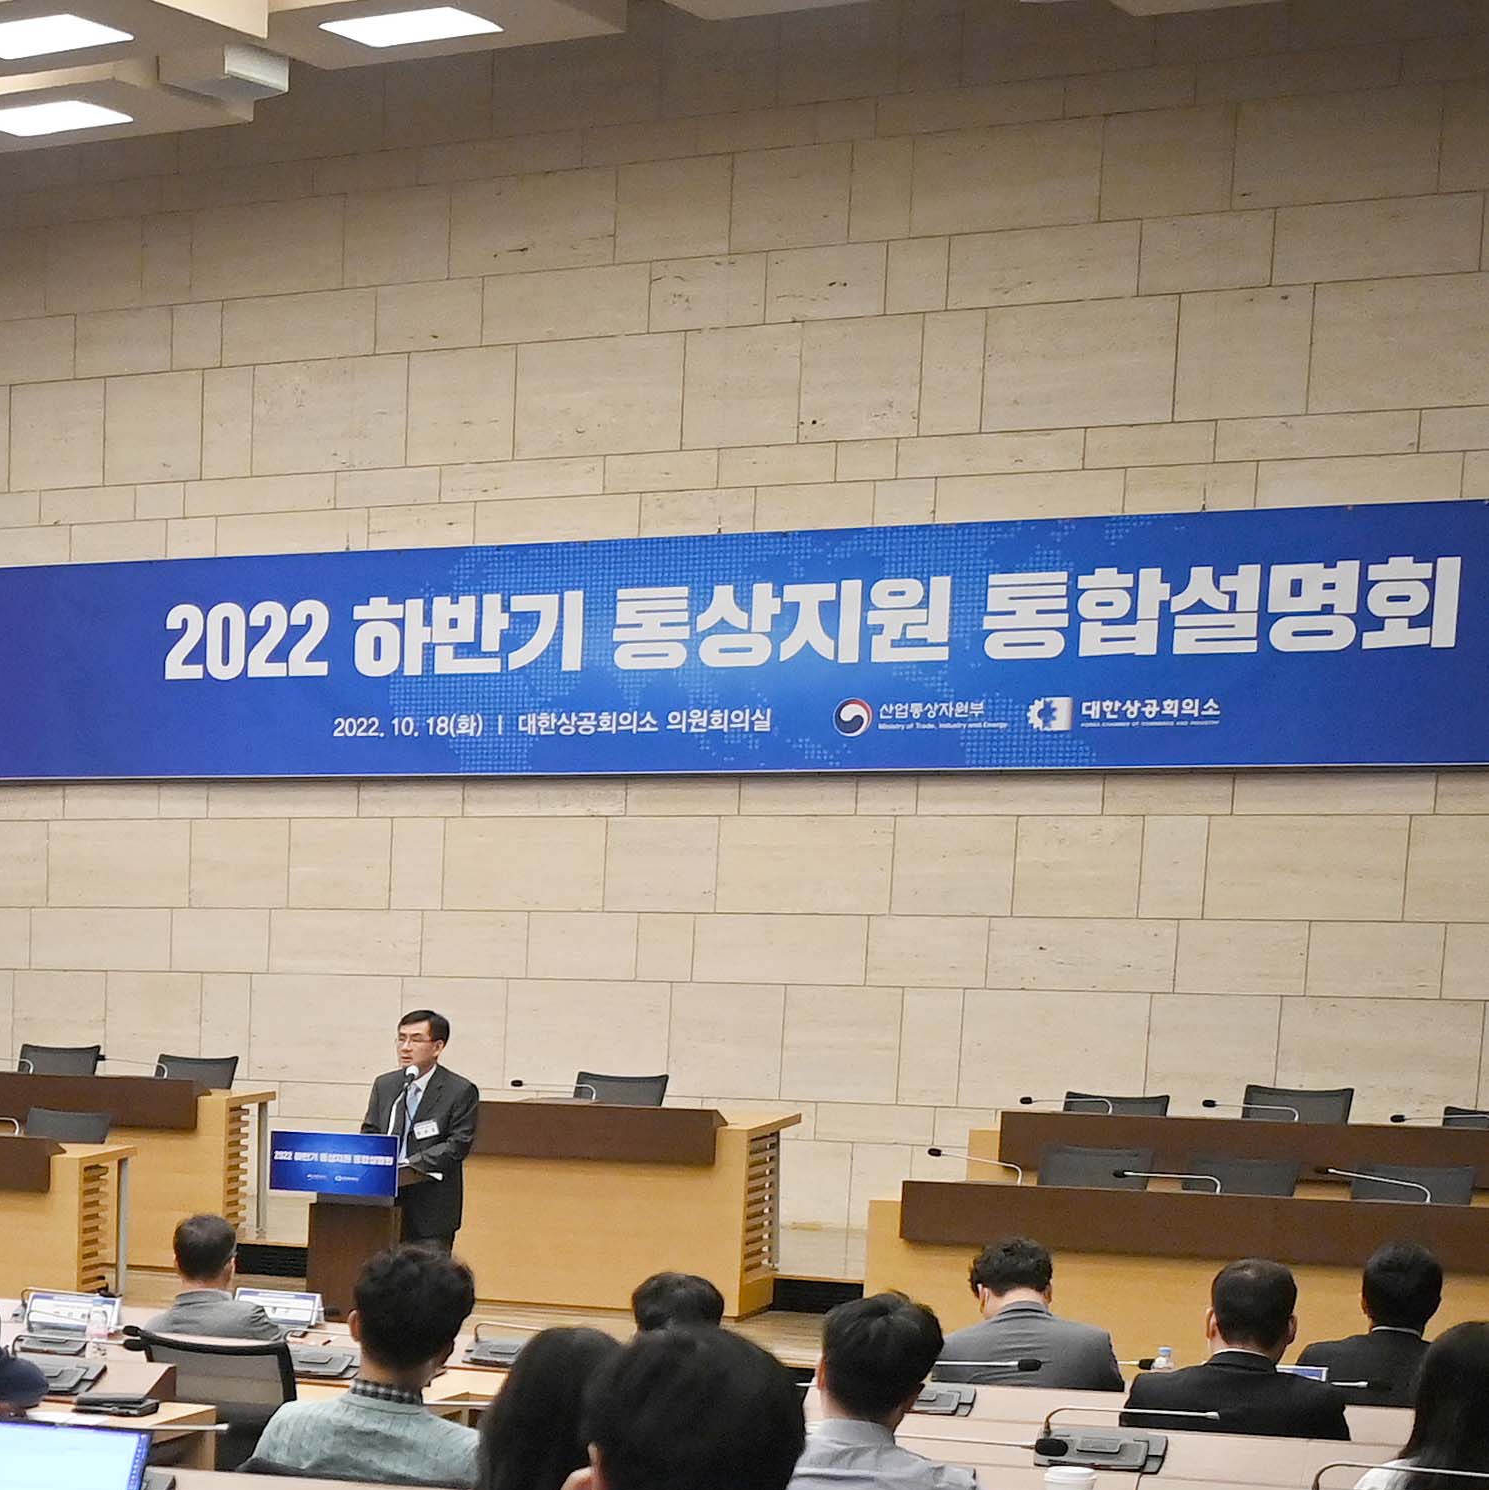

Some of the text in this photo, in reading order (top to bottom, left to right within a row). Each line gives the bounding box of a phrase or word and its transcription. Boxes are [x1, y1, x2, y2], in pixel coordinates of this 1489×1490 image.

[164, 555, 1463, 681] 2022 하반기 통상지원 통합설명회
[878, 700, 986, 720] 산업통상자원부
[1080, 697, 1221, 720] 대한상공회의소
[332, 717, 385, 738] 2022.
[391, 718, 420, 738] 10.
[425, 716, 484, 738] 18(화)
[517, 711, 659, 736] 대한상공회의소
[665, 708, 773, 733] 의원회의실
